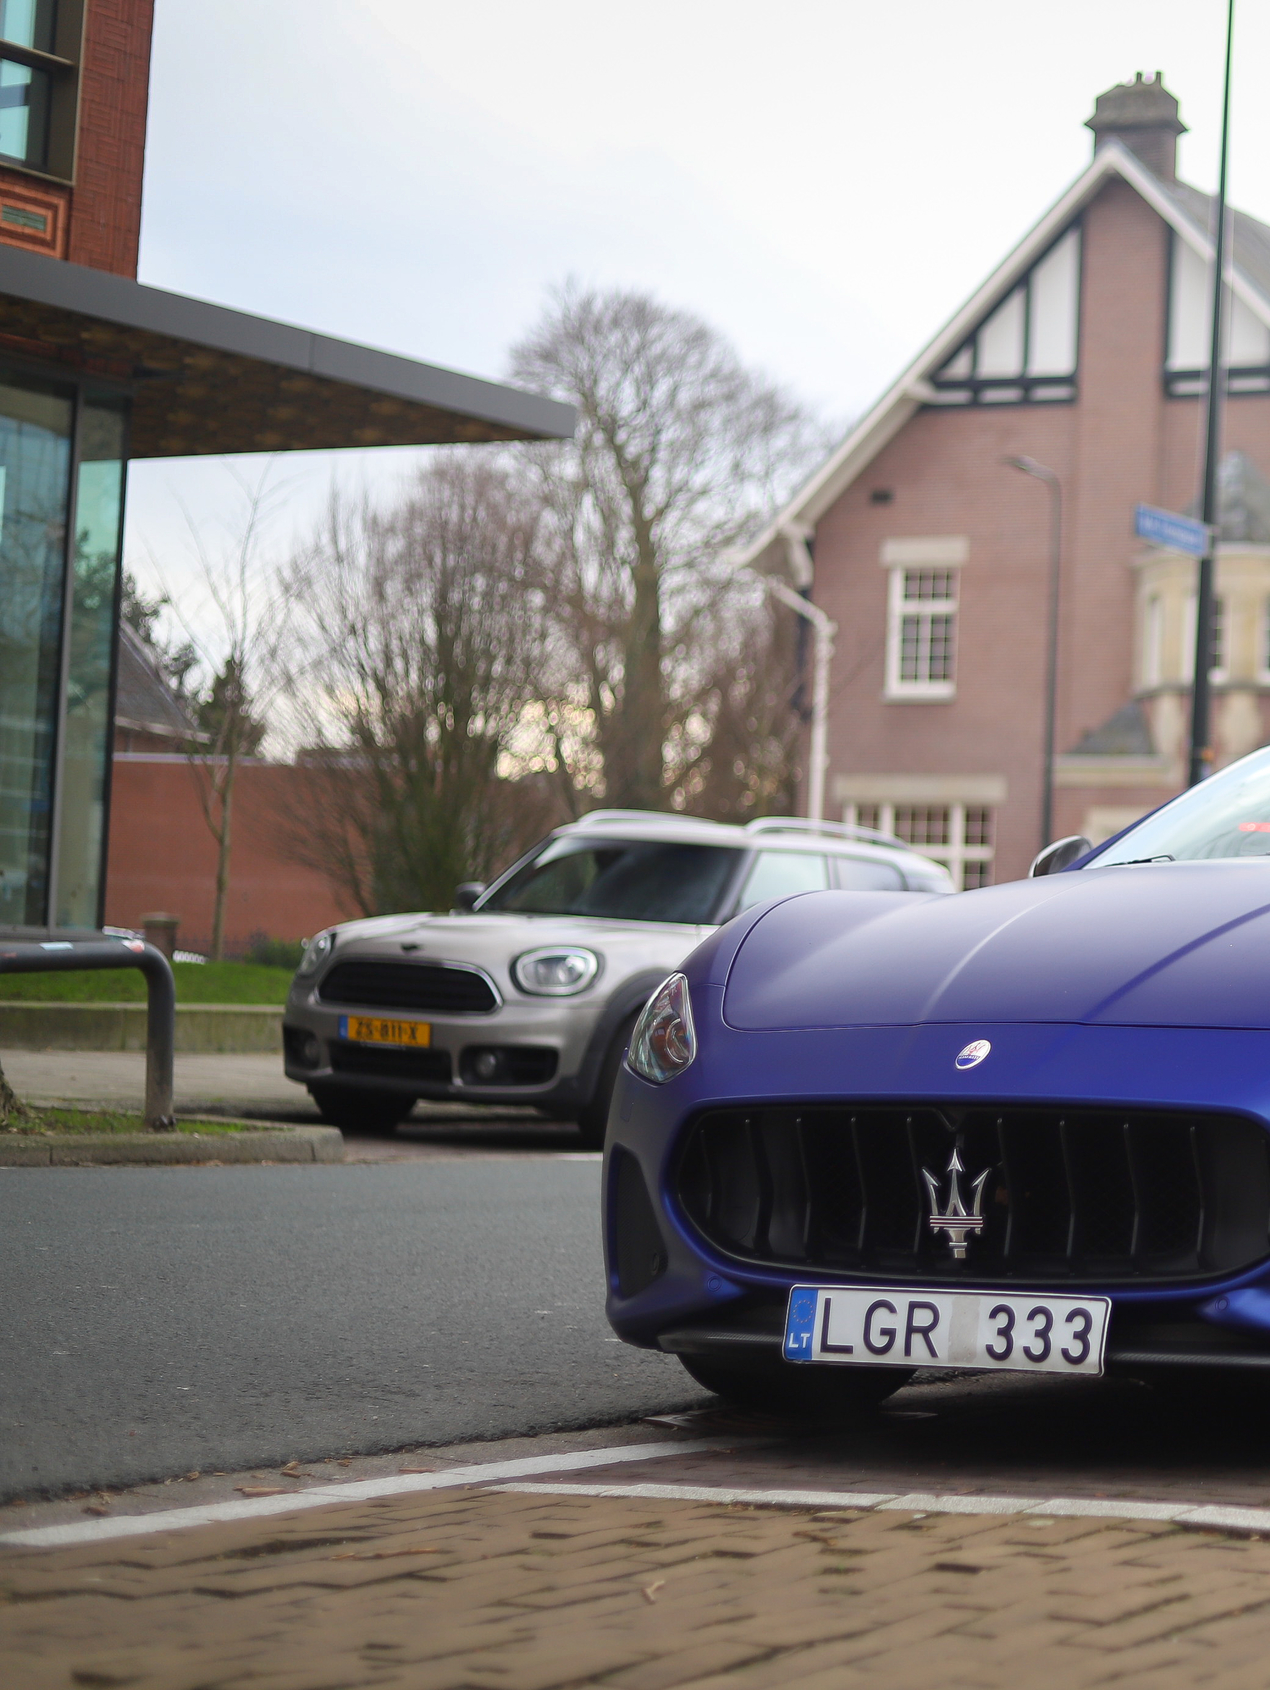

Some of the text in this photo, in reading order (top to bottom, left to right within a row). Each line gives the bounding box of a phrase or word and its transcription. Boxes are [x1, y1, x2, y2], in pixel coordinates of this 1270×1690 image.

[788, 1332, 810, 1348] LT
[819, 1297, 1093, 1366] LGR 333
